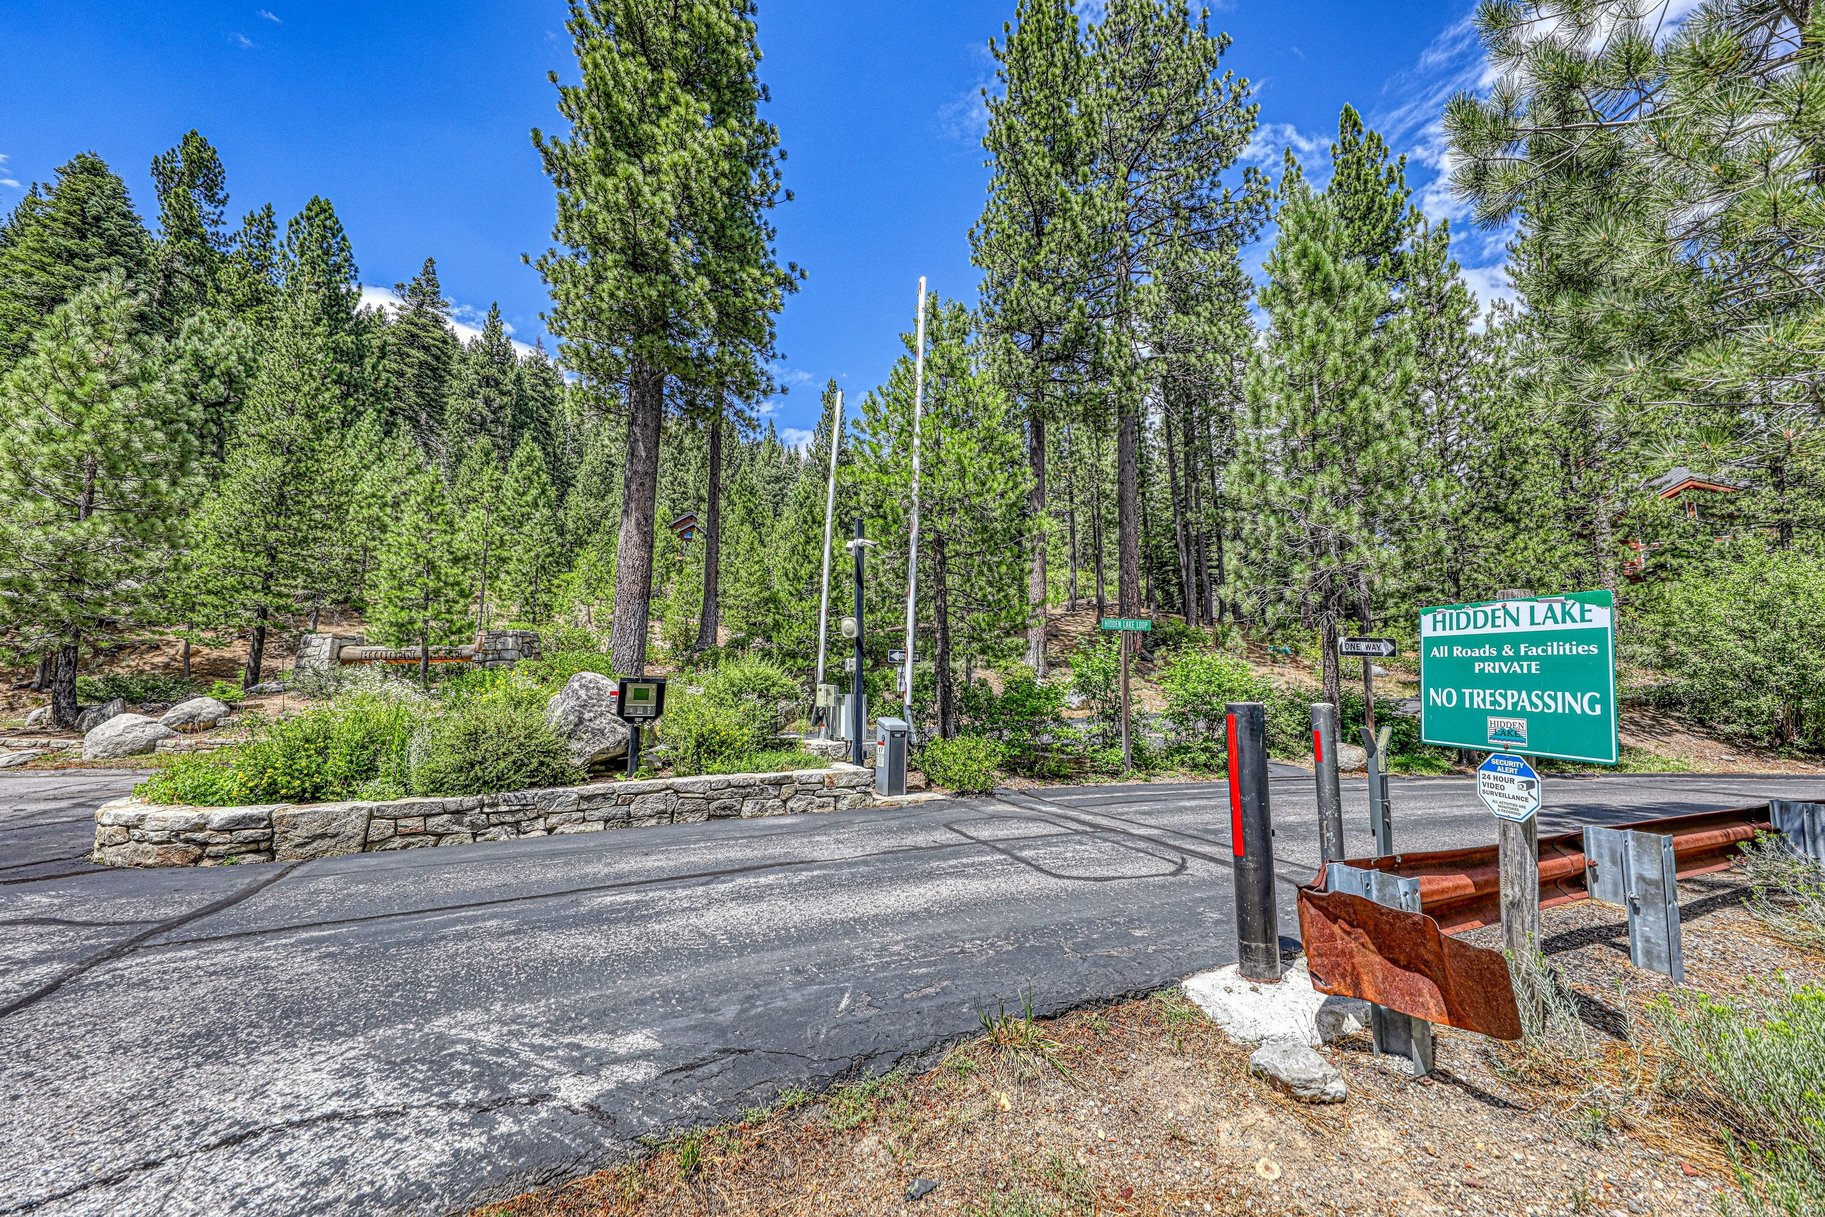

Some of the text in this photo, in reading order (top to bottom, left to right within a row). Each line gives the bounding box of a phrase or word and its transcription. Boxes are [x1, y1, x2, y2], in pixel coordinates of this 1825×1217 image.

[1432, 601, 1593, 632] HIDDEN LAKE
[1105, 620, 1148, 629] HIDDEN LAKE LOOP
[1365, 643, 1381, 651] WAY
[1430, 641, 1599, 658] All Roads & Facilities
[1474, 661, 1541, 674] PRIVATE
[1429, 687, 1602, 716] NO TRESPASSING
[1488, 719, 1525, 730] HIDDEN
[1494, 728, 1521, 738] LAKE
[1491, 759, 1524, 768] SECURITY
[1497, 766, 1518, 774] ALERT
[1493, 775, 1515, 784] HOUR
[1482, 782, 1505, 791] VIDEO
[1482, 789, 1529, 802] SURVEILLANCE
